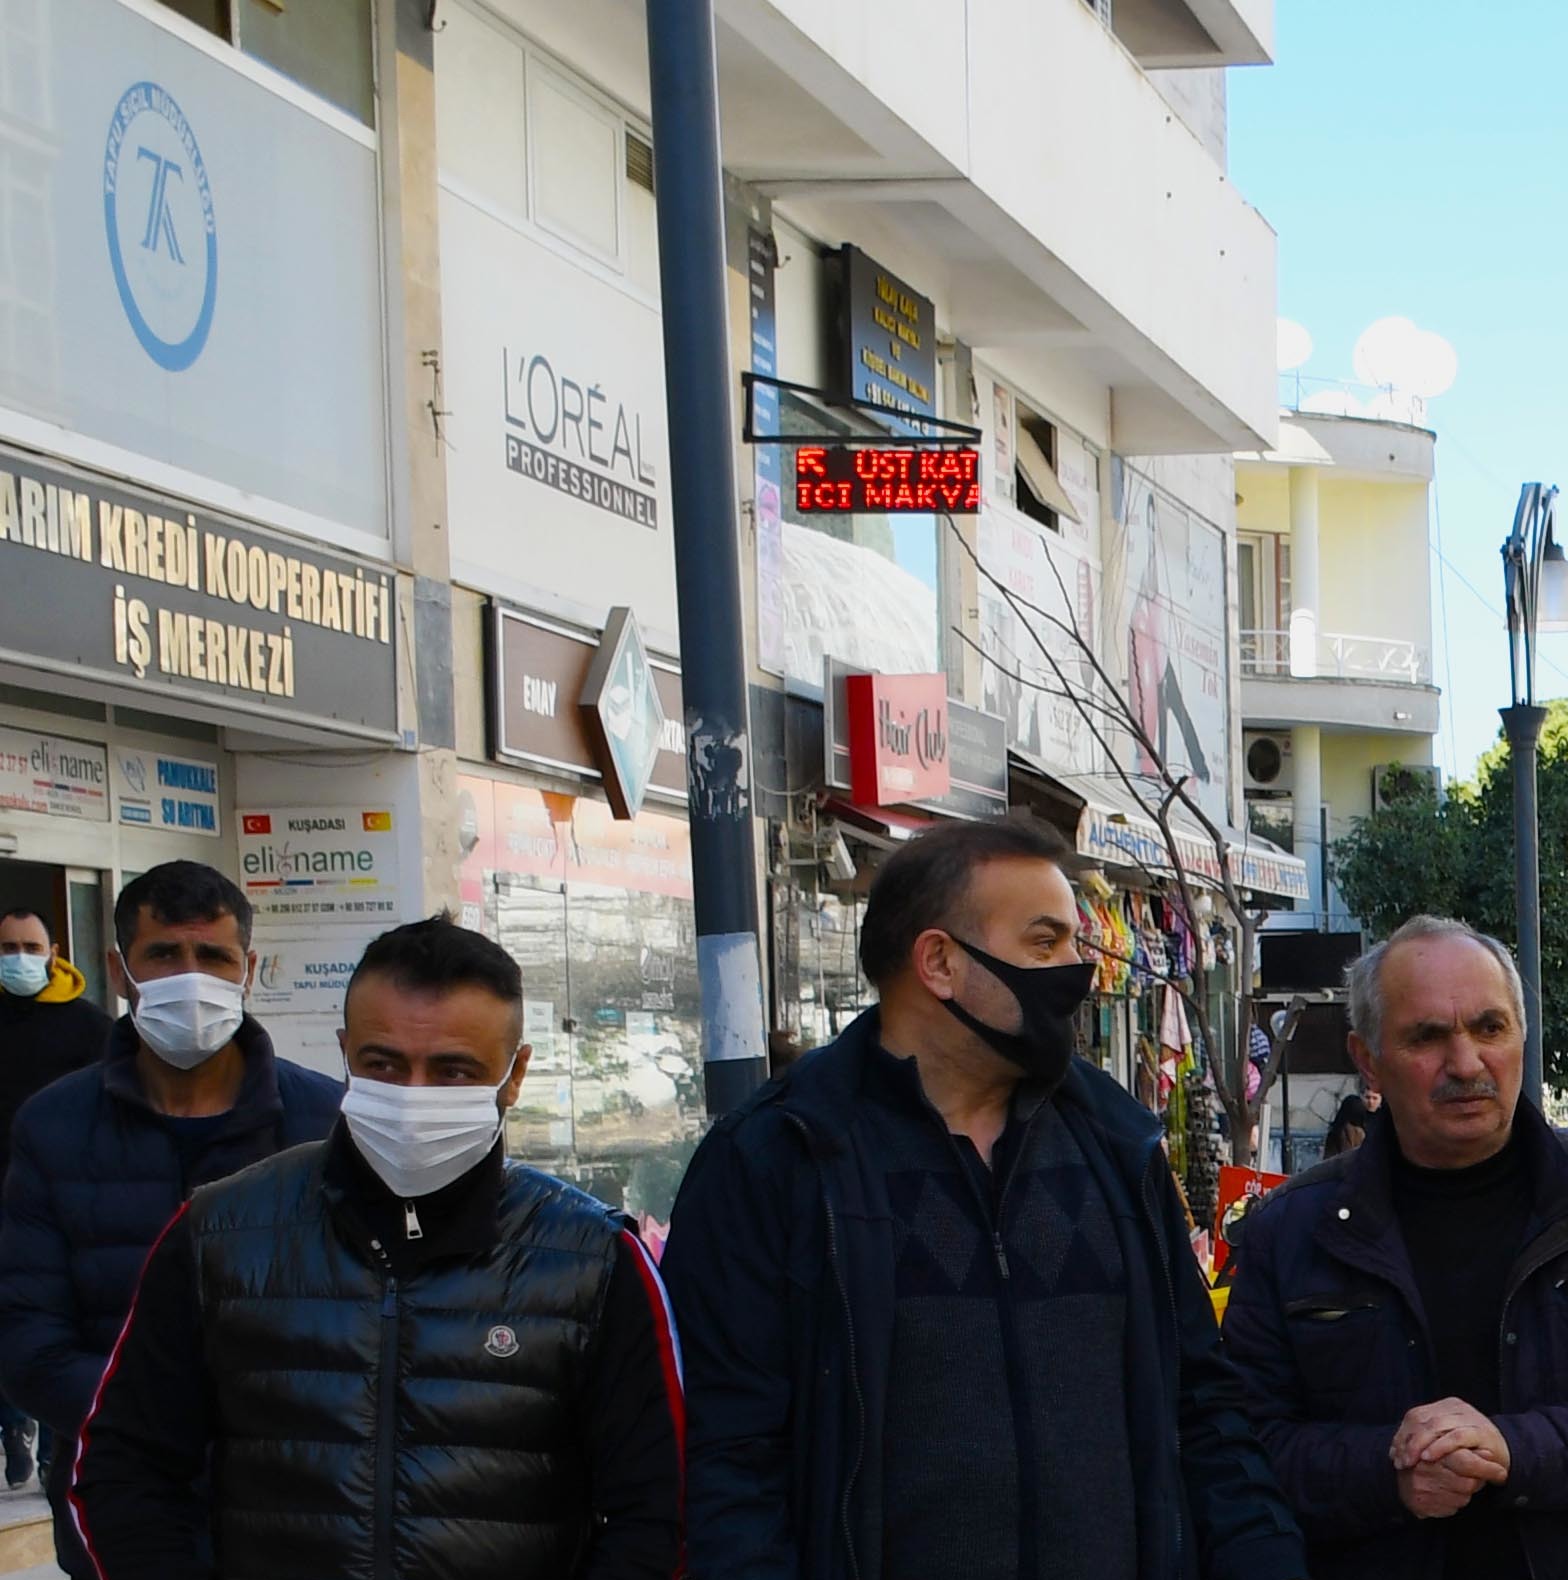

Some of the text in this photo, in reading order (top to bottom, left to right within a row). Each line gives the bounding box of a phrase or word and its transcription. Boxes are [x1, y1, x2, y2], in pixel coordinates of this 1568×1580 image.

[503, 347, 656, 488] L'ORÉAL
[507, 438, 657, 530] PROFESSIONNEL
[920, 452, 977, 479] KAT
[866, 483, 981, 508] MAKYA
[0, 470, 390, 644] ARIM KREDİ KOOPERATİFİ
[114, 584, 295, 698] İŞ MERKEZİ
[878, 698, 911, 756] Hair
[915, 707, 946, 771] Club
[157, 759, 217, 794] PAMUKKALE
[288, 818, 346, 834] KUŞADASI
[1089, 824, 1164, 867] AUTHENTIC
